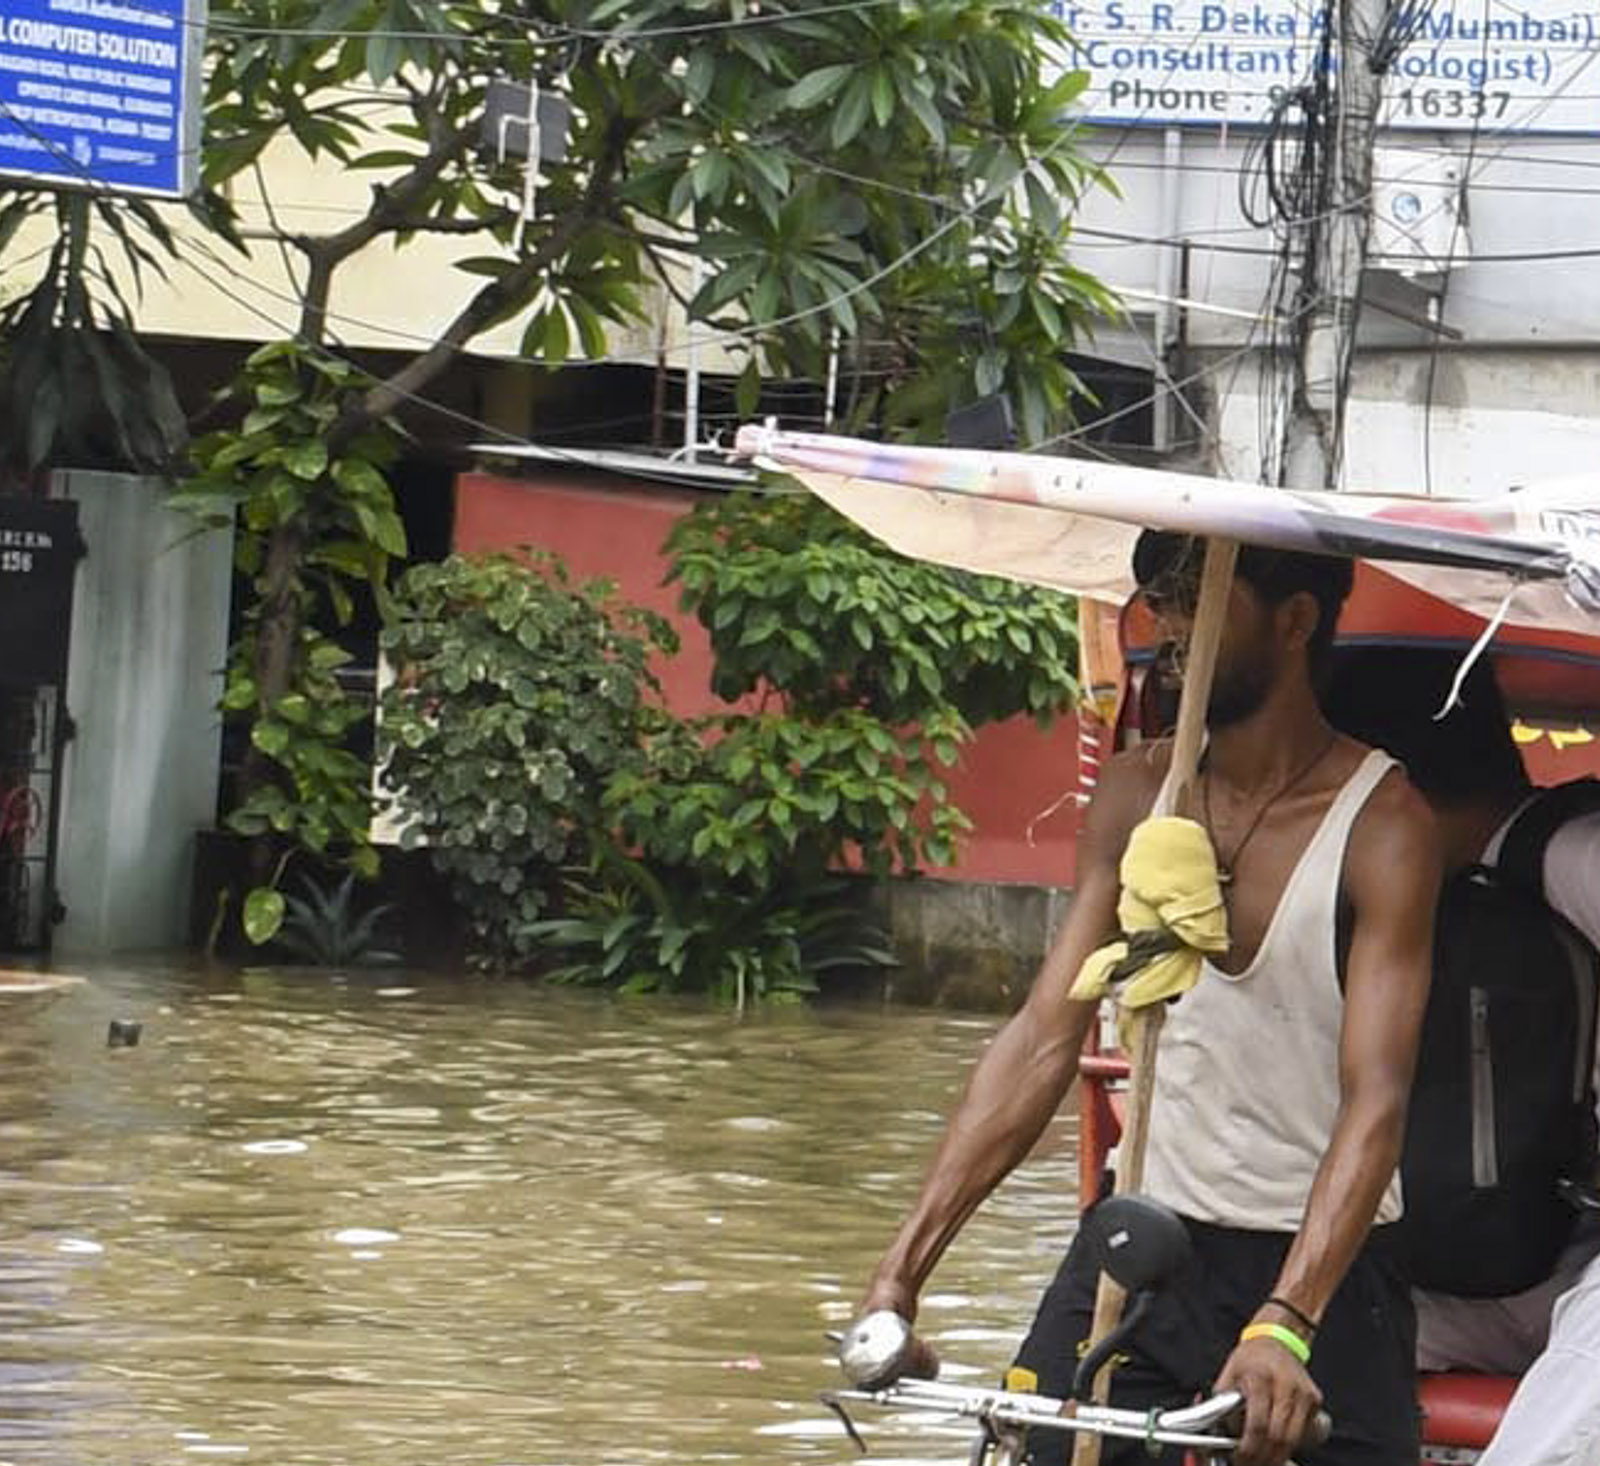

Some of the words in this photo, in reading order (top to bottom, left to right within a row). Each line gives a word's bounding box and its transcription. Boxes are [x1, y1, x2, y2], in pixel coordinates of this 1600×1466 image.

[1105, 2, 1137, 31] S.
[1152, 4, 1185, 32] R.
[1201, 5, 1296, 36] Deka
[9, 17, 97, 58] COMPUTER
[98, 31, 177, 70] SOLUTION
[1073, 41, 1298, 74] (Consultant
[1110, 79, 1228, 111] Phone
[1401, 90, 1511, 119] 16337
